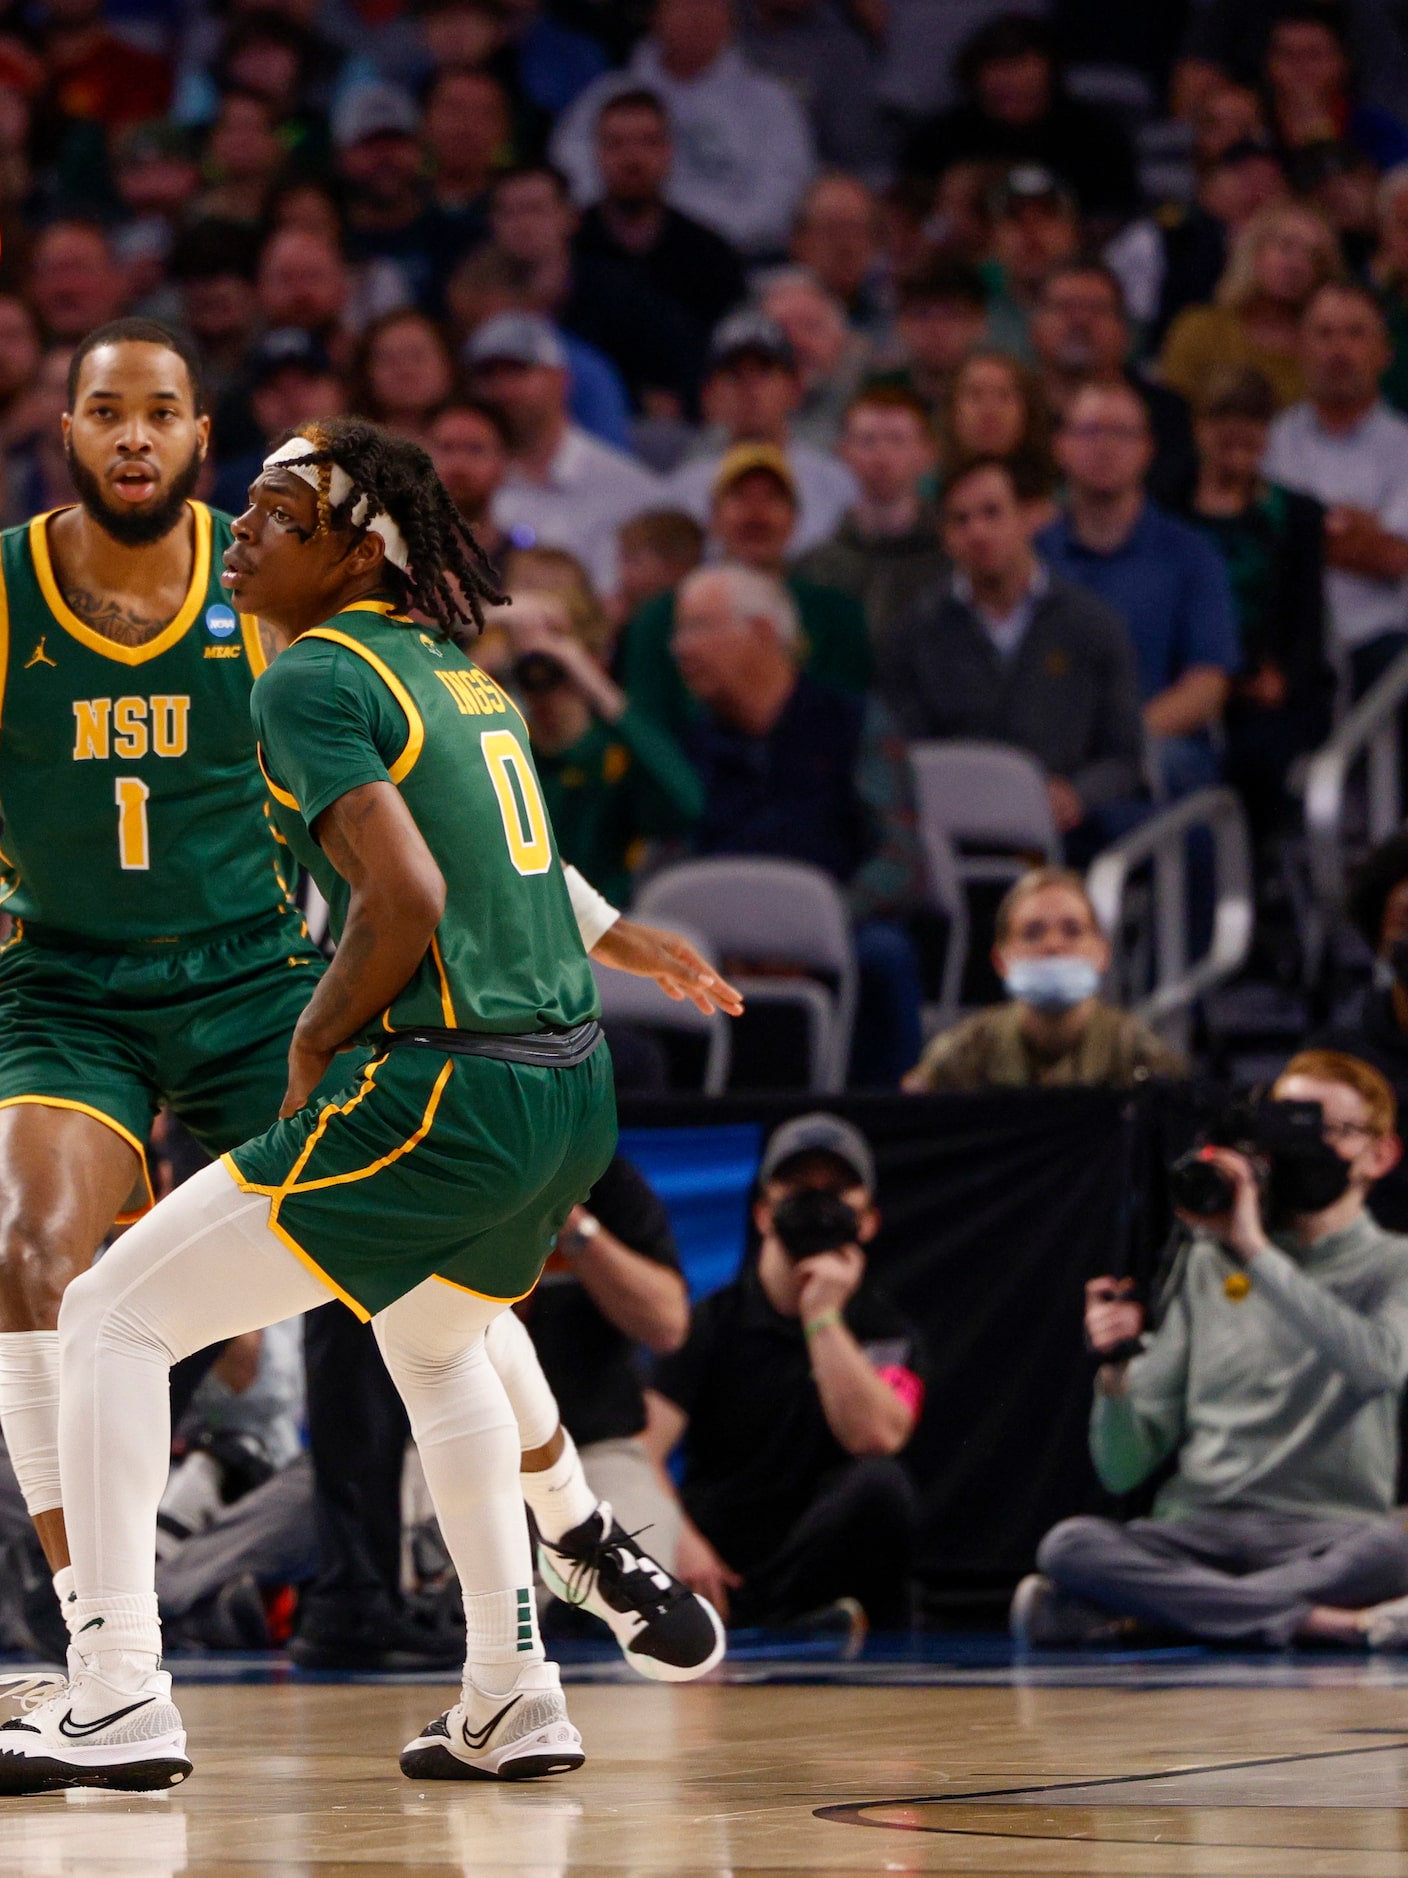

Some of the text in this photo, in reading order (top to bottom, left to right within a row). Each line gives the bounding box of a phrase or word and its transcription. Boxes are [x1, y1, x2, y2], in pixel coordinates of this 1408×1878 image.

[72, 695, 191, 761] NSU
[115, 777, 150, 870] 1
[480, 730, 552, 876] 0
